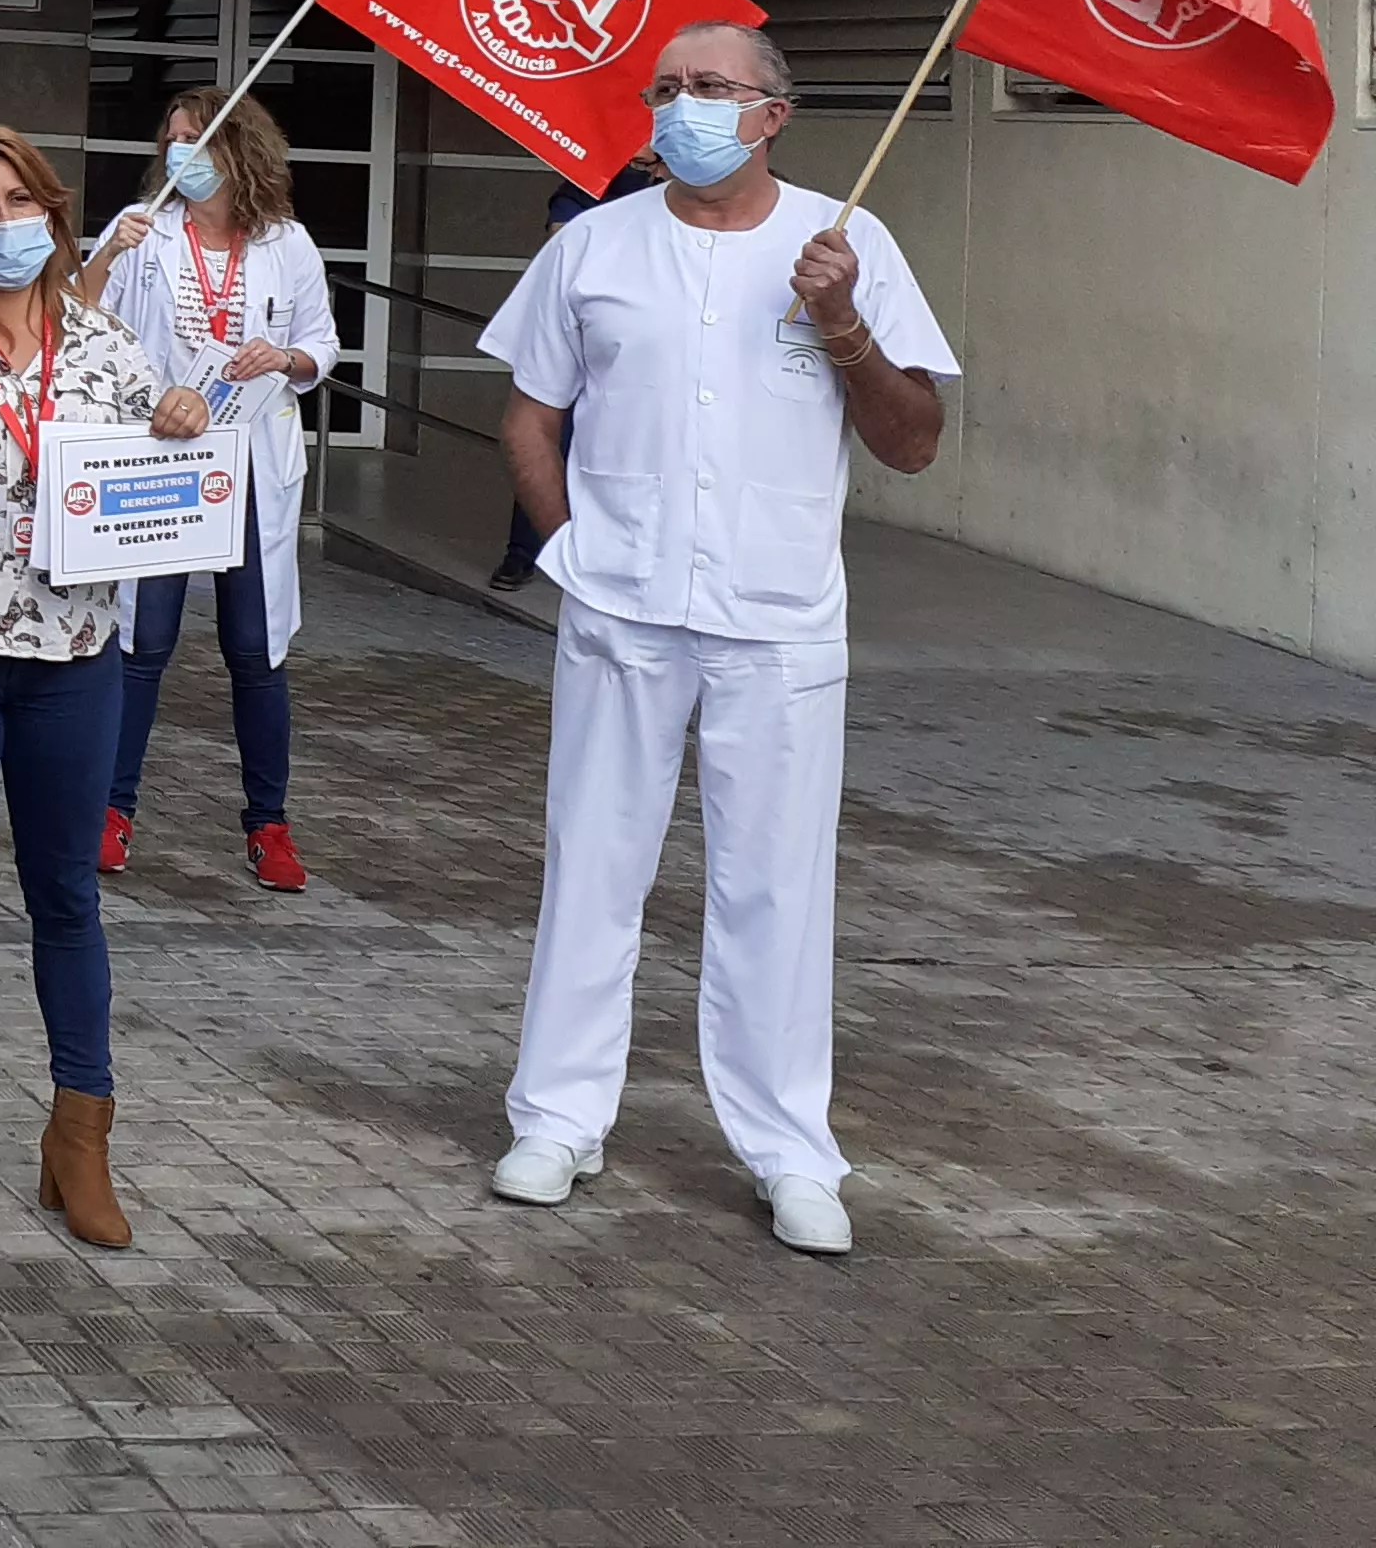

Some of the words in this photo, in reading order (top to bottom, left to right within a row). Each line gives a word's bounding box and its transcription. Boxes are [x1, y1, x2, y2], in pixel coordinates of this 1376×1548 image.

[83, 460, 110, 471] POR
[113, 456, 170, 468] NUESTRA
[173, 451, 215, 462] SALUD
[106, 483, 131, 493] POR
[133, 476, 194, 491] NUESTROS
[203, 474, 229, 489] UGT
[68, 486, 93, 501] UGT
[119, 494, 181, 508] DERECHOS
[93, 524, 111, 534] NO
[114, 517, 178, 532] QUEREMOS
[180, 514, 204, 524] SER
[118, 531, 179, 545] ESCLAVOS
